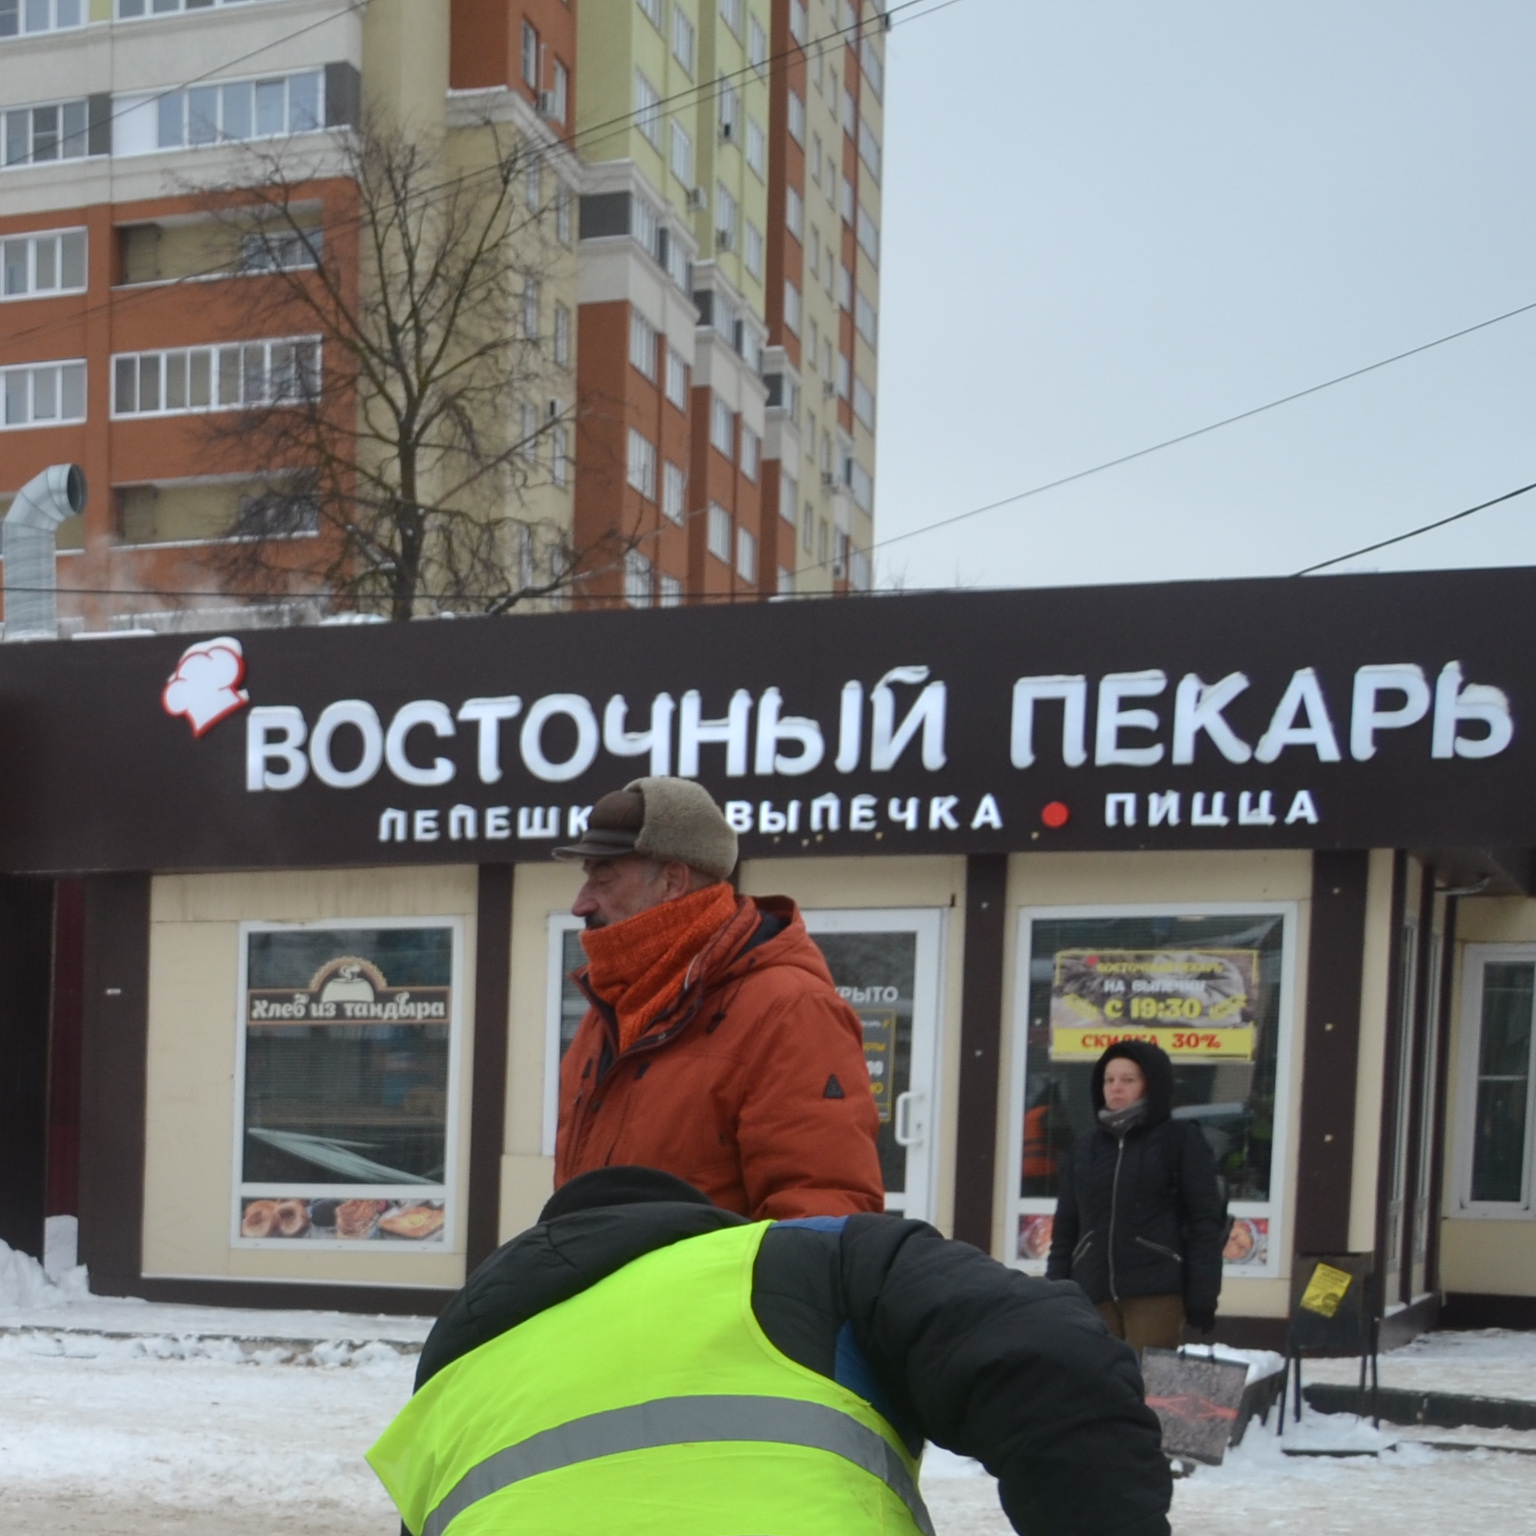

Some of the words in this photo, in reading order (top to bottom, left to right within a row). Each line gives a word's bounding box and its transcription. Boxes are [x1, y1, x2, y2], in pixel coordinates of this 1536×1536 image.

[245, 666, 947, 792] ВОСТОЧНЫЙ
[1010, 660, 1514, 768] ПЕКАРЬ
[378, 806, 590, 842] ЛЕПЕШК
[725, 793, 1003, 834] ВЫПЕЧКА
[1104, 789, 1319, 827] ПИЦЦА
[835, 985, 899, 1002] РЫТО
[1103, 979, 1126, 993] НА
[253, 993, 308, 1018] Хлеб
[310, 1002, 336, 1017] из
[344, 992, 444, 1019] тандыра
[1131, 998, 1202, 1019] 19:30
[1171, 1032, 1222, 1050] 30%
